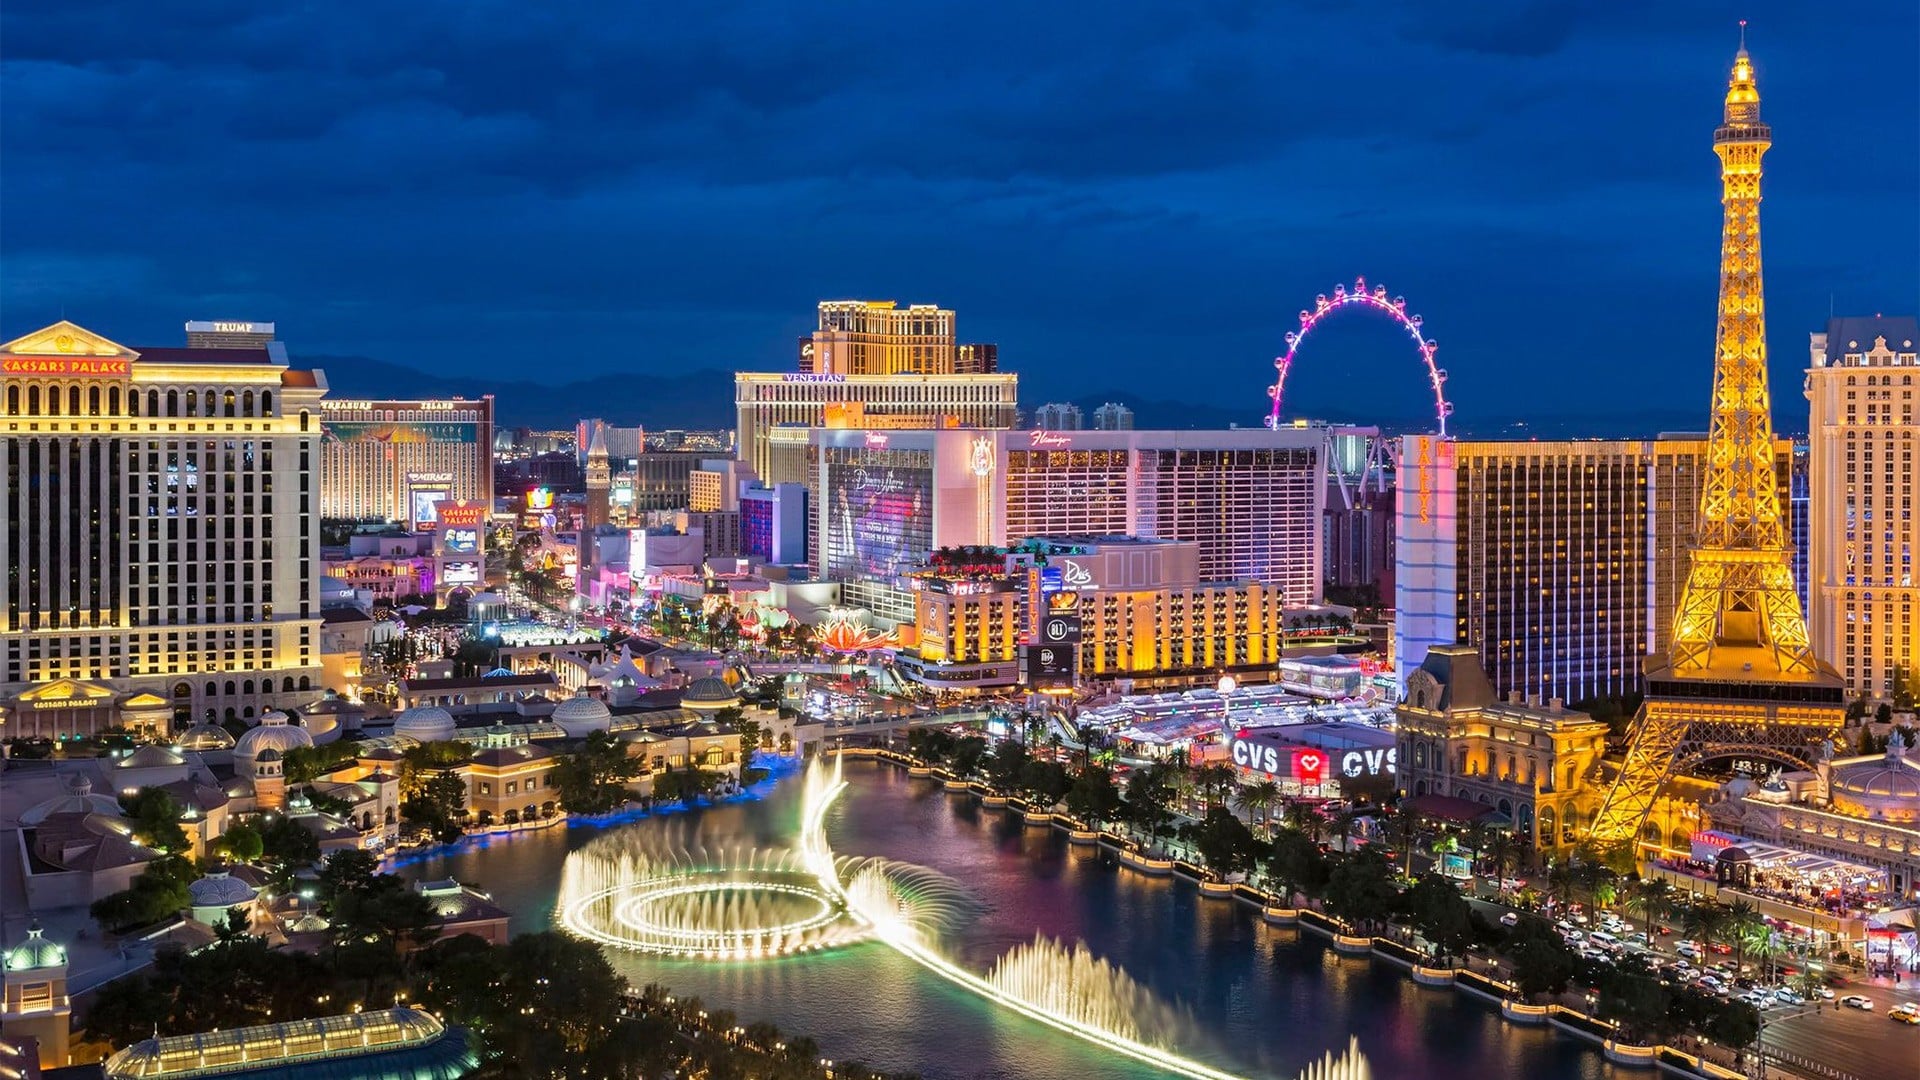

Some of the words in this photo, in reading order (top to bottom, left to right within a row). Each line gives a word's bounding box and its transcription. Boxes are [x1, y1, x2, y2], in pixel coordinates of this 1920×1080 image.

[214, 323, 252, 333] TRUMP
[3, 361, 66, 373] CAESARS
[71, 362, 126, 373] PALACE
[785, 374, 843, 383] VENETIAN
[320, 402, 372, 410] TREASURE
[420, 402, 453, 410] ISLAND
[1030, 430, 1072, 447] Flamingo
[443, 508, 479, 516] CAESARS
[445, 517, 477, 525] PALACE
[1051, 623, 1063, 636] BLT
[1233, 739, 1278, 773] CVS
[1710, 836, 1731, 848] PARK
